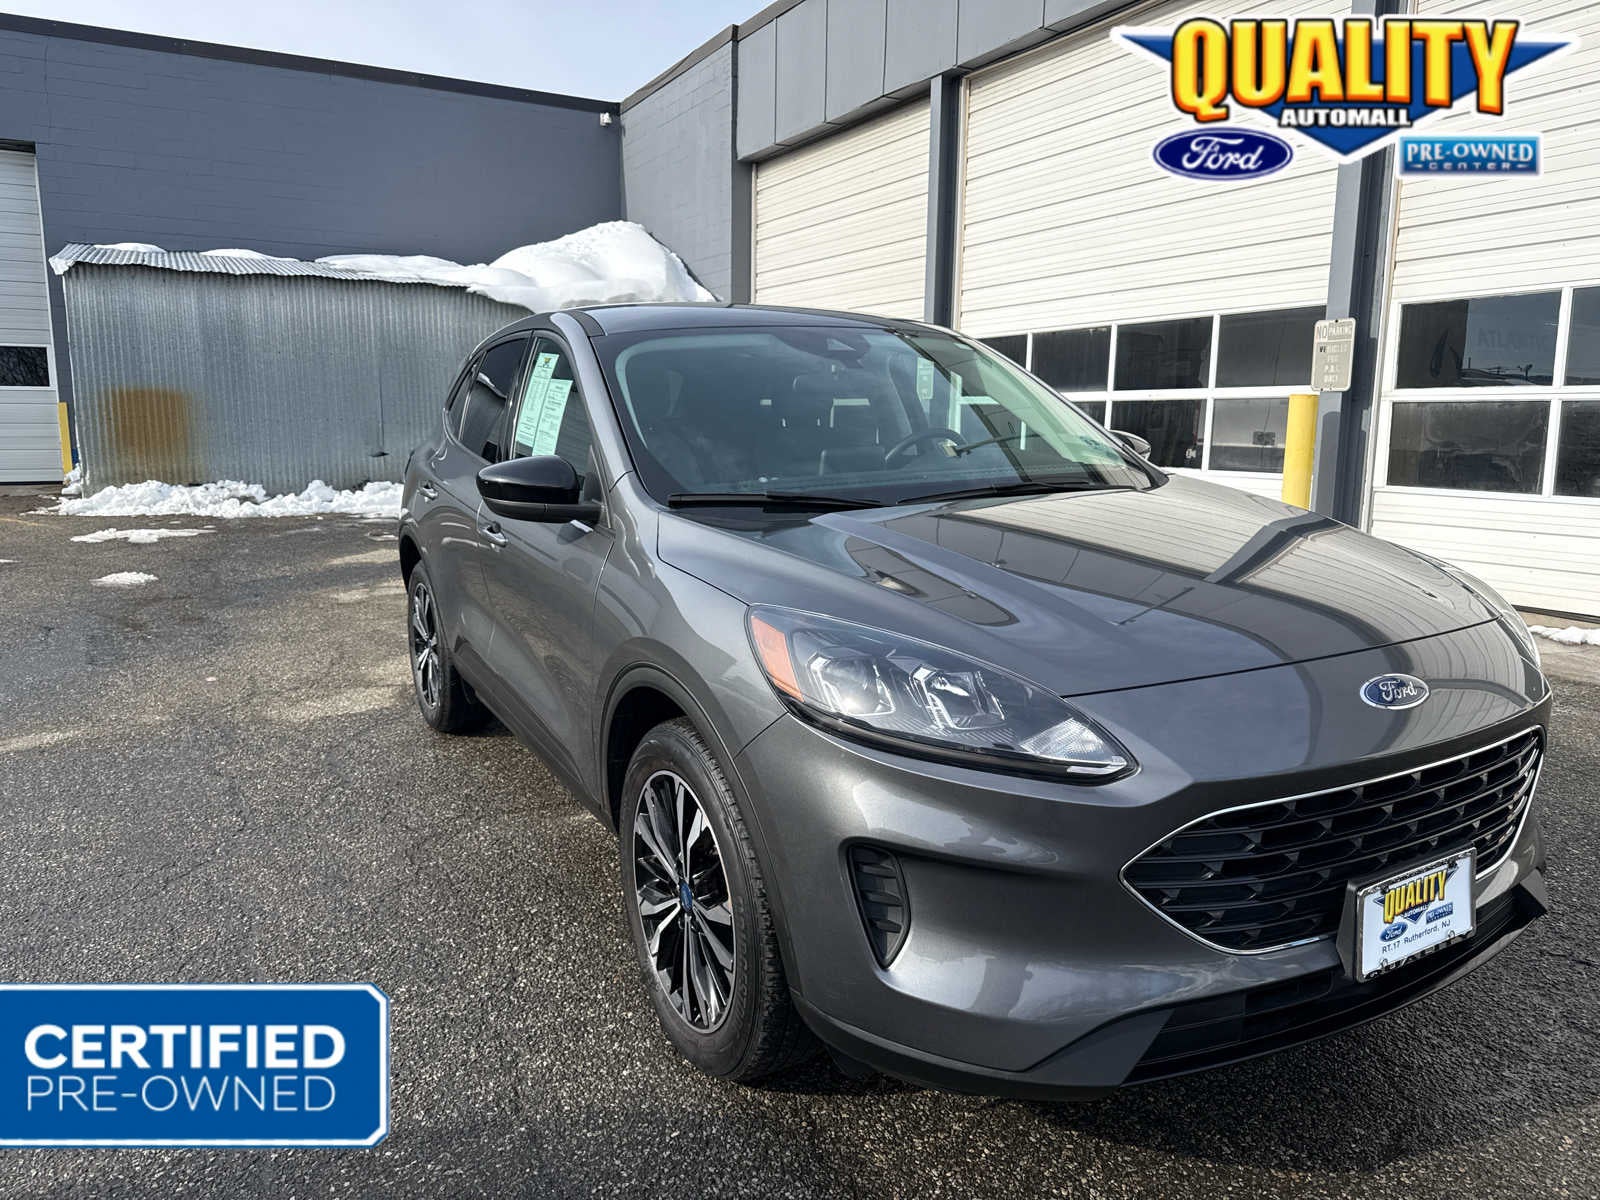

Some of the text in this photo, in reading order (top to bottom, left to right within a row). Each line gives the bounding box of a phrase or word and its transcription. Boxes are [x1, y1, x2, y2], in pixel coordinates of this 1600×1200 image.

[1315, 325, 1328, 339] NO
[1379, 679, 1418, 702] Ford
[1384, 869, 1448, 924] QUALITY
[1441, 919, 1451, 929] NJ
